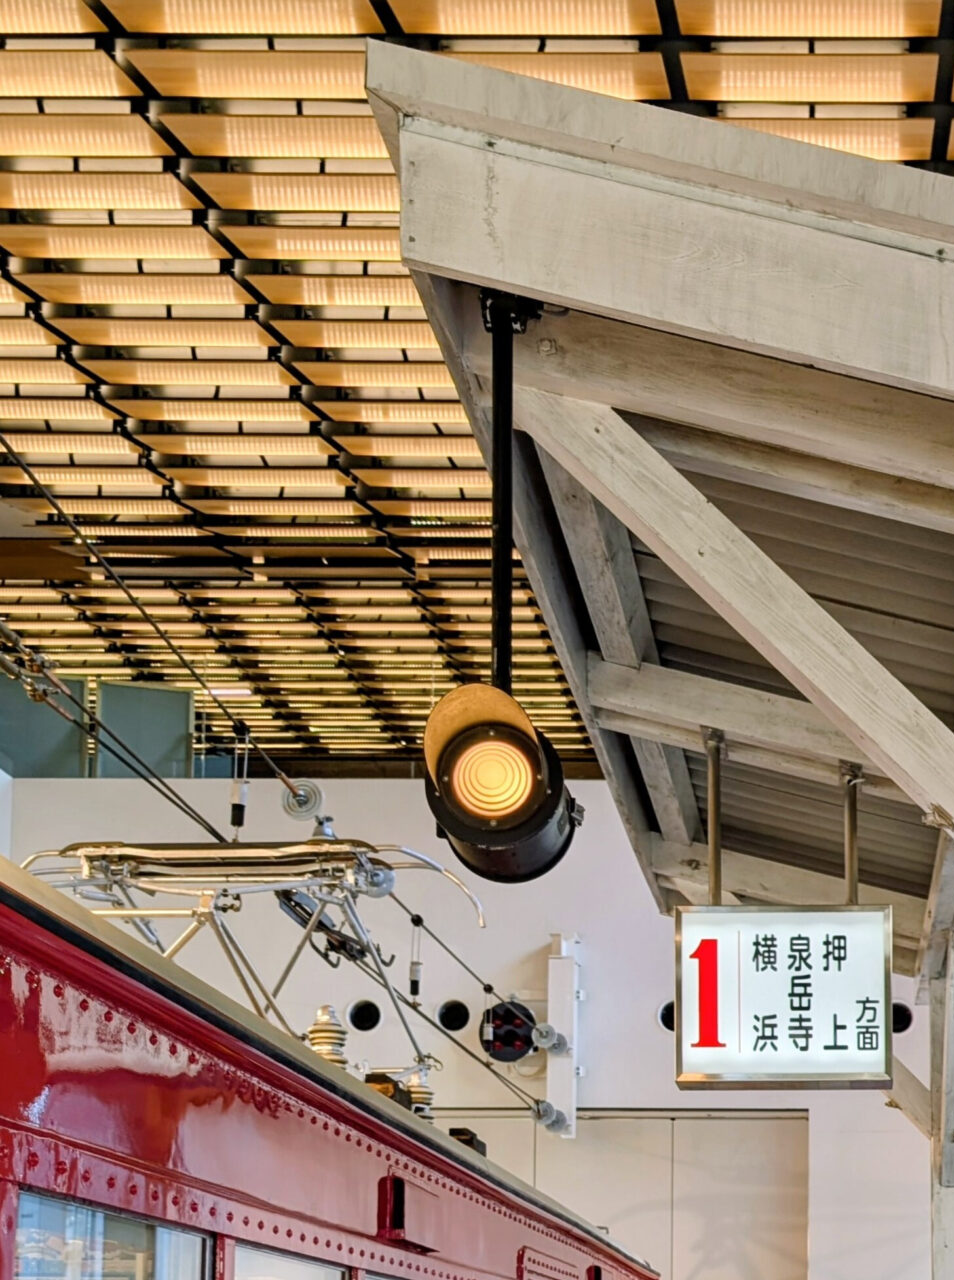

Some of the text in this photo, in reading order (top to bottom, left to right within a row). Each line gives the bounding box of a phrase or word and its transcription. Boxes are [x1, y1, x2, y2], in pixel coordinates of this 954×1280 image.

[689, 938, 727, 1048] 1
[752, 933, 778, 1052] 横浜
[787, 933, 813, 1052] 泉岳寺
[822, 933, 849, 1051] 押上
[855, 996, 880, 1051] 方面
